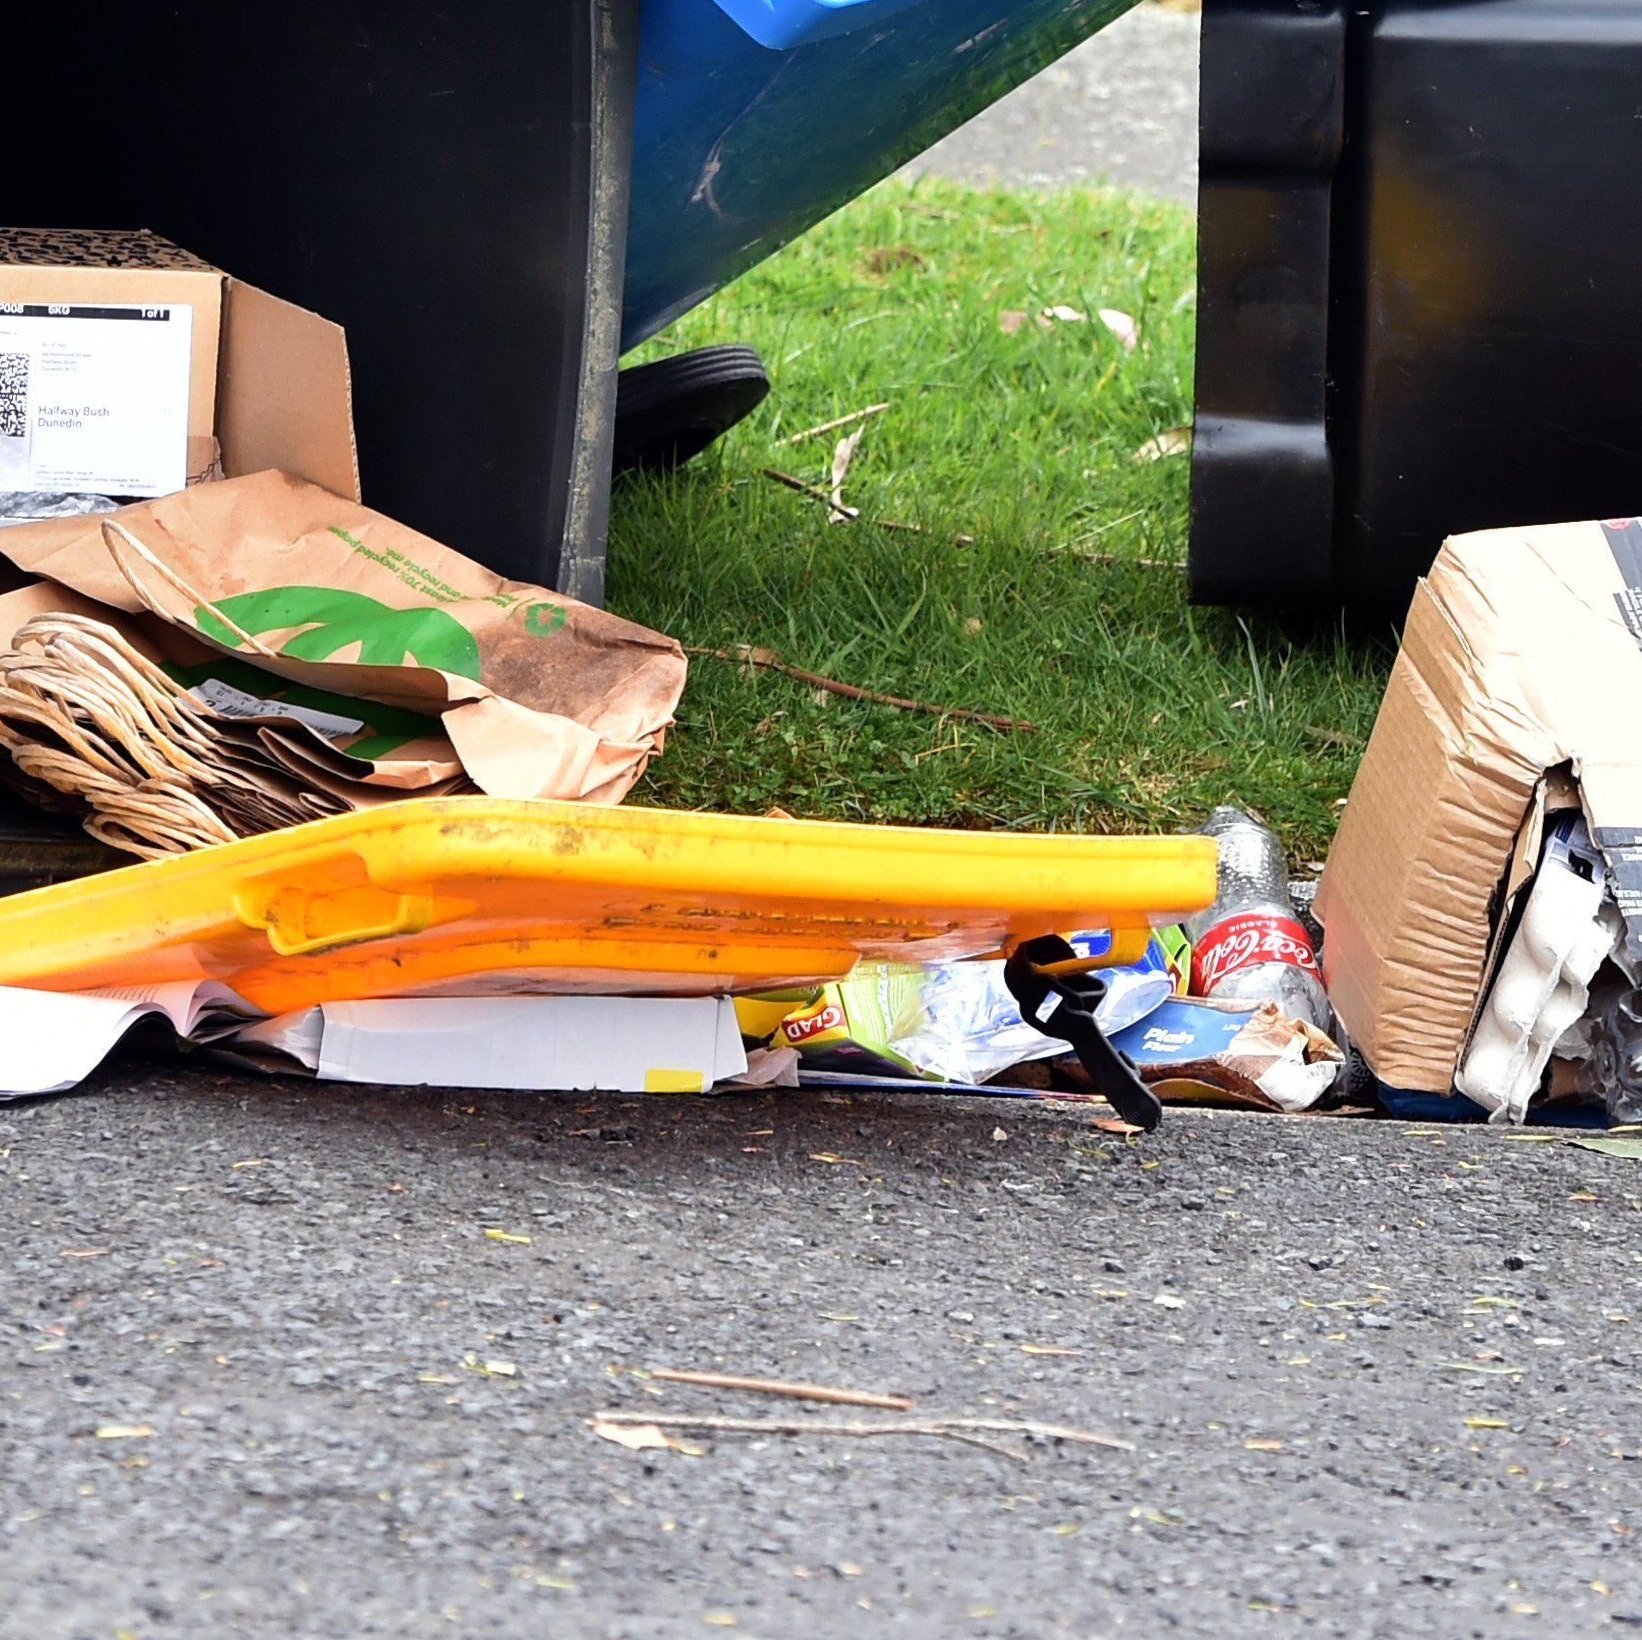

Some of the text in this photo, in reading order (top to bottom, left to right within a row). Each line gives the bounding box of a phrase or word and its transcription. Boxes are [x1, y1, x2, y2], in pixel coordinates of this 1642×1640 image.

[38, 405, 110, 418] Halfway Bush
[38, 417, 82, 429] Dunedin
[403, 558, 442, 587] recycle
[1202, 929, 1317, 994] Coca-Cola
[786, 1006, 842, 1042] GLAD
[1143, 1026, 1195, 1045] Plain
[1141, 1040, 1181, 1053] Flour
